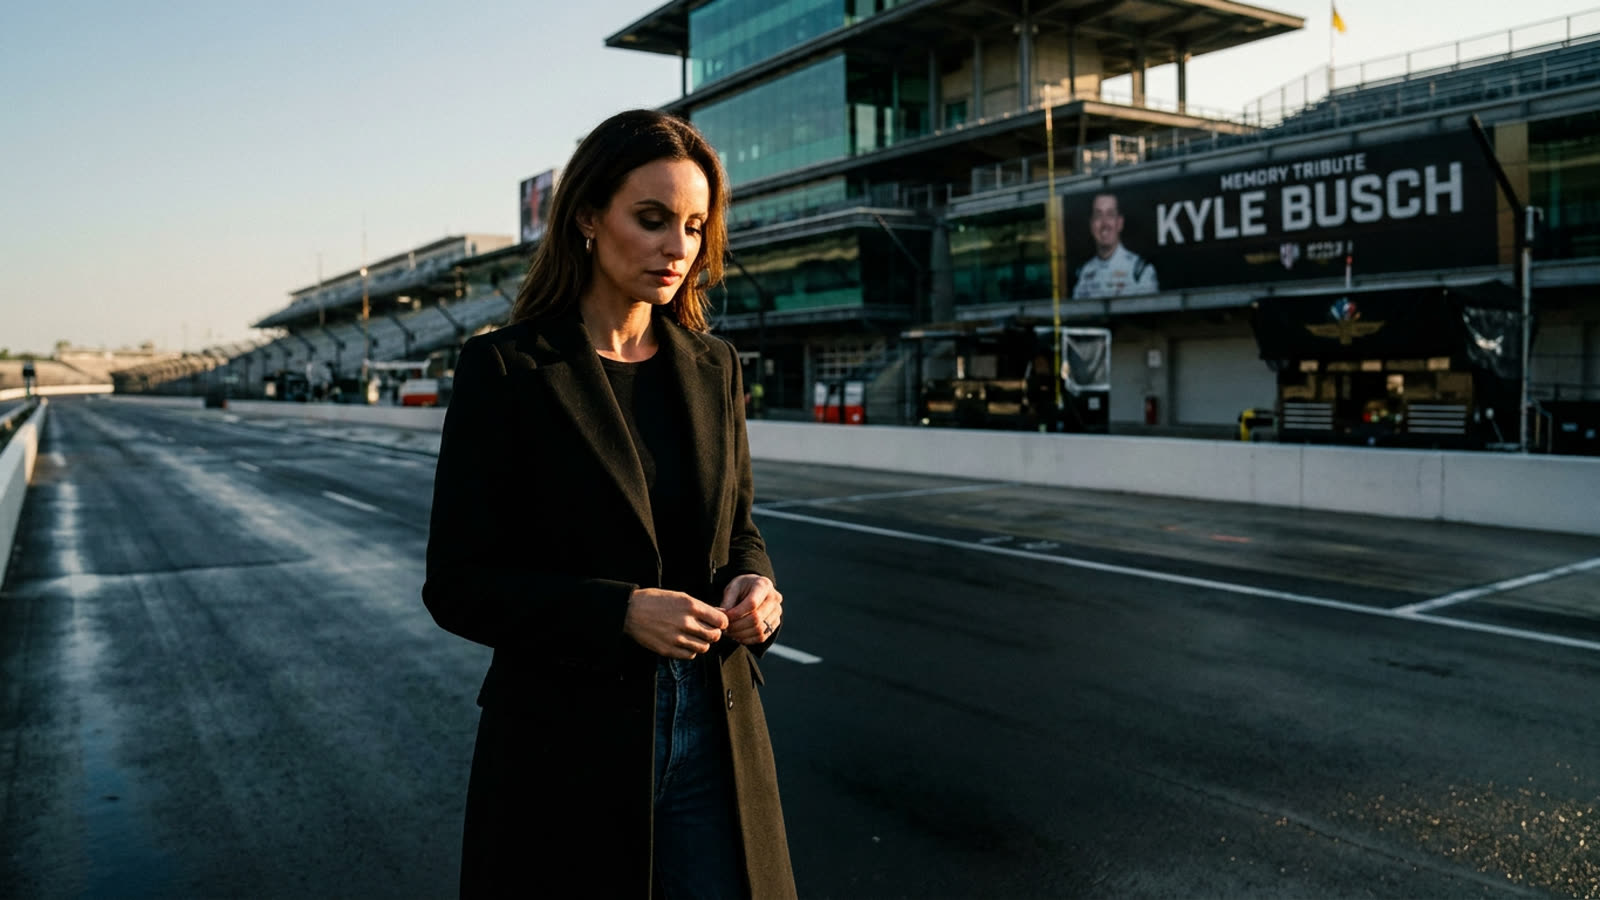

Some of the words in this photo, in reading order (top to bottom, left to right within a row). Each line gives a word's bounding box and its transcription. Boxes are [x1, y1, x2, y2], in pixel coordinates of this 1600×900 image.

[1221, 166, 1288, 190] MEMORY
[1293, 153, 1366, 177] TRIBUTE
[1156, 190, 1267, 246] KYLE
[1282, 162, 1463, 232] BUSCH
